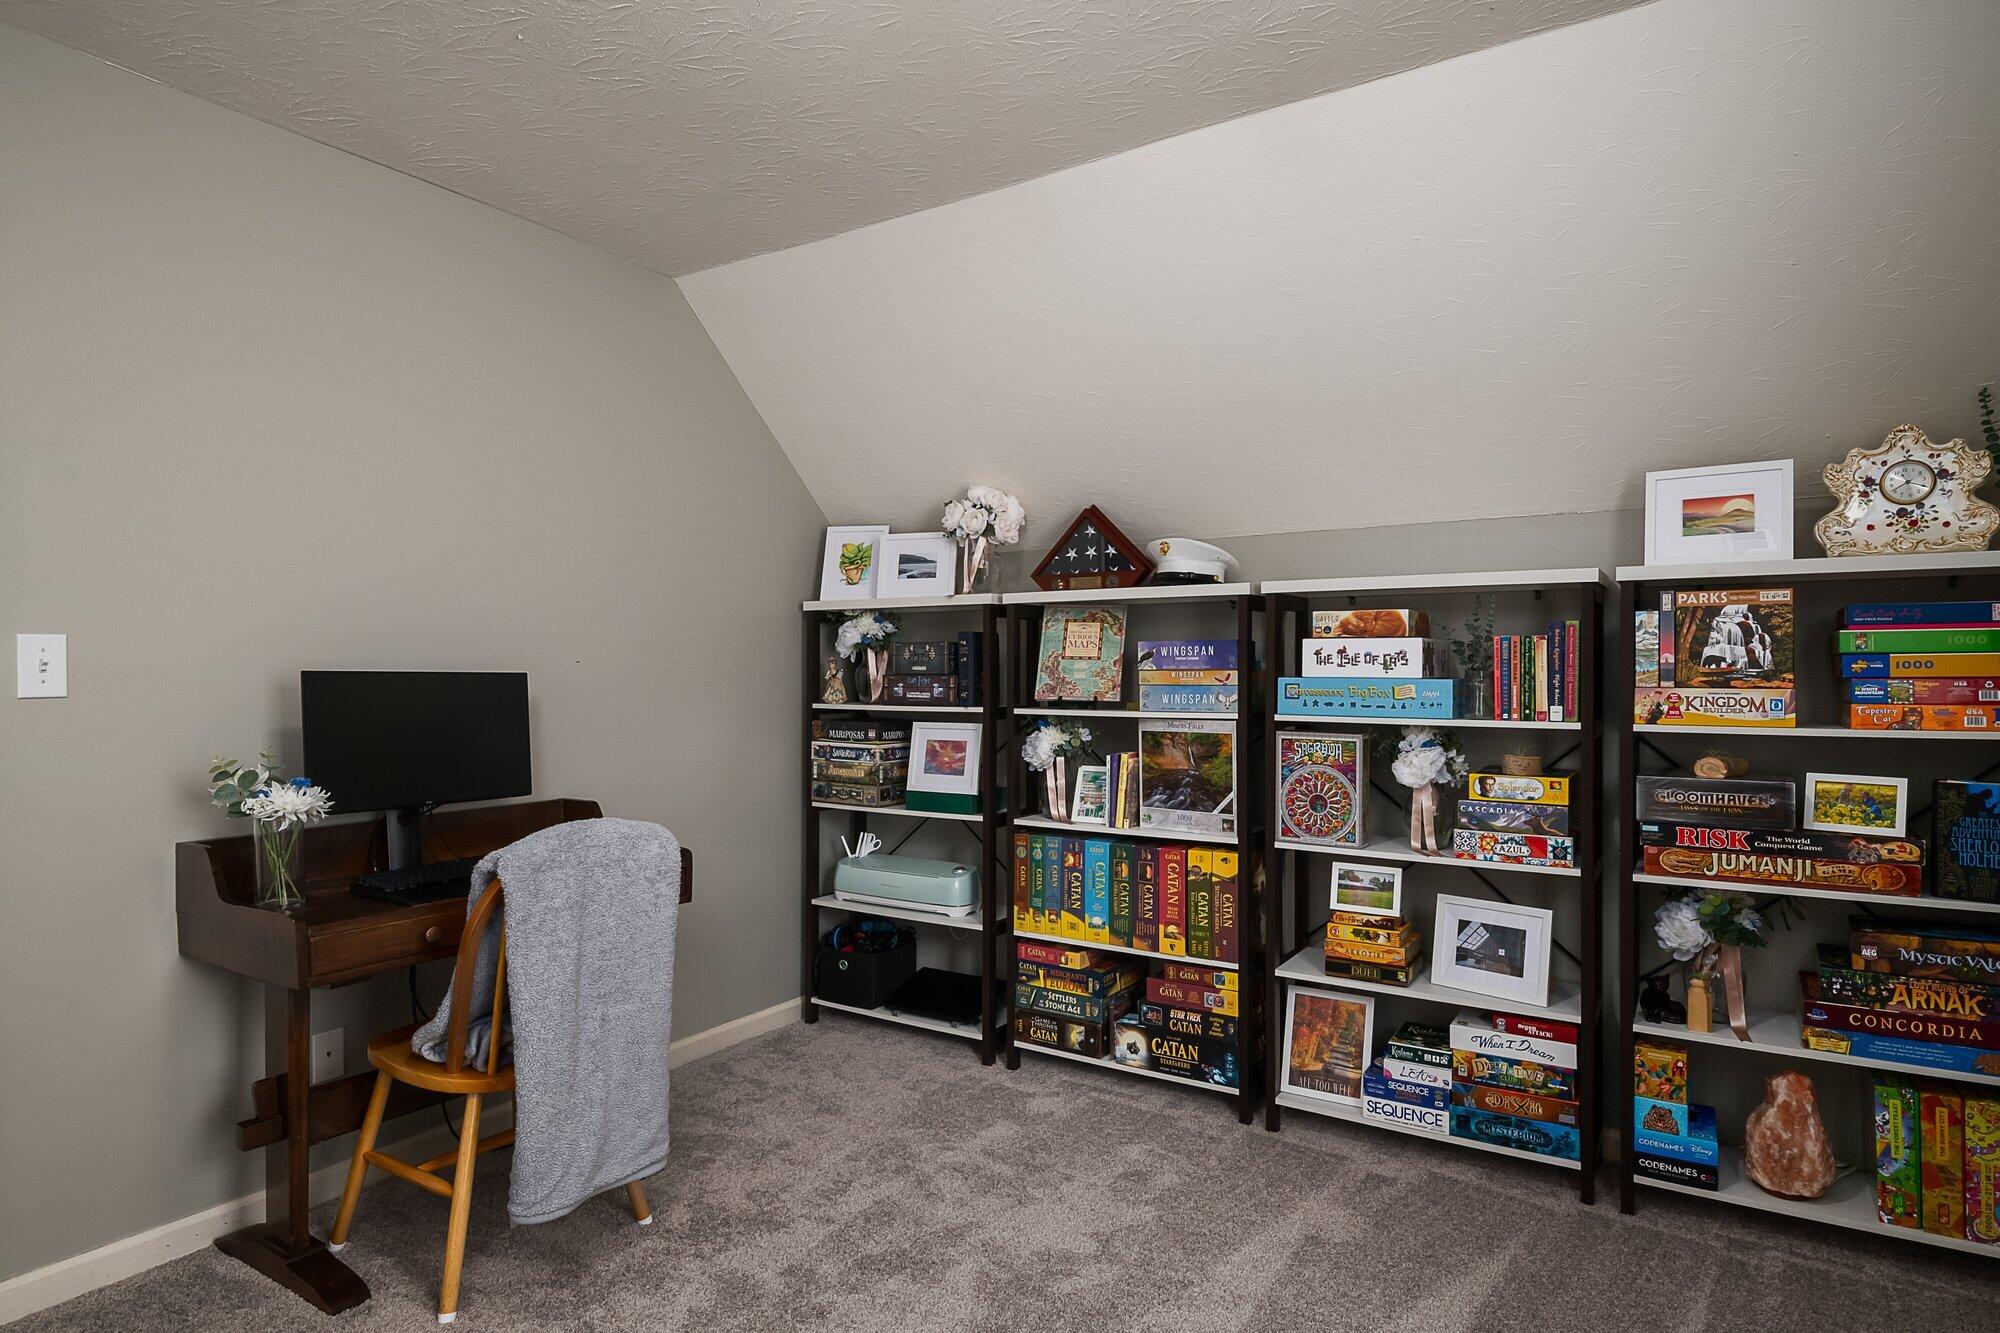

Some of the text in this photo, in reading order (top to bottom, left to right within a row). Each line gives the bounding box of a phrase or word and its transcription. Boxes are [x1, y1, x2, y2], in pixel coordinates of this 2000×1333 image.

[1678, 592, 1728, 604] PARKS
[1948, 635, 1987, 645] 1000
[1161, 646, 1214, 656] WINGSPAN
[1314, 651, 1334, 666] THE
[1337, 650, 1361, 667] ISLE
[1364, 652, 1379, 665] OF
[1896, 660, 1934, 669] 1000
[1162, 694, 1215, 704] WINGSPAN
[1285, 684, 1344, 699] Carcassonne
[1348, 686, 1368, 700] Big
[1368, 686, 1390, 699] Box
[1684, 696, 1767, 714] KINGDOM
[1856, 706, 1897, 717] Tapestry
[1874, 714, 1891, 724] Cat
[829, 730, 865, 739] MARIPOSAS
[1294, 742, 1343, 764] SAGRADA
[1498, 783, 1537, 793] Splendor
[1655, 789, 1775, 808] GLOOMHAVEN
[1460, 805, 1517, 814] CASCADIA
[1959, 817, 2000, 828] GREATES
[1676, 826, 1751, 850] RISK
[1499, 845, 1525, 854] AZUL
[1755, 841, 1795, 850] Conquest
[1951, 838, 2000, 854] SHERLO
[1704, 852, 1812, 882] JUMANJI
[1959, 852, 2000, 868] HOLME
[1095, 862, 1106, 899] CATAN
[1167, 863, 1179, 904] CATAN
[1071, 872, 1082, 909] CATAN
[1120, 883, 1129, 916] CATAN
[1144, 885, 1153, 919] CATAN
[1198, 892, 1209, 927] CATAN
[1222, 894, 1233, 928] CATAN
[1027, 948, 1046, 956] CATAN
[1345, 949, 1385, 959] AKROTIRI
[1898, 948, 1962, 966] MYSTIC
[1019, 962, 1037, 971] CATAN
[1351, 966, 1377, 978] DUEL
[1050, 969, 1086, 982] MERCHANTS
[1180, 971, 1199, 980] CATAN
[1050, 980, 1086, 993] EUROPE
[1160, 987, 1183, 998] CATAN
[1909, 981, 1969, 994] LOST RUINS OF
[1048, 992, 1076, 1004] SETTLERS
[1888, 983, 1986, 1016] ARNAK
[1045, 1000, 1081, 1014] STONE AGE
[1170, 1009, 1202, 1022] STAR TREK
[1031, 1020, 1058, 1030] THRONES
[1170, 1019, 1202, 1035] CATAN
[1849, 1013, 1983, 1040] CONCORDIA
[1030, 1028, 1058, 1042] CATAN
[1152, 1037, 1198, 1061] CATAN
[1392, 1046, 1413, 1058] Kodama
[1471, 1035, 1555, 1062] When I Dream
[1160, 1058, 1190, 1069] STARFARERS
[1299, 1076, 1311, 1089] ALL
[1315, 1079, 1330, 1091] TOO
[1333, 1083, 1352, 1096] WELL
[1500, 1074, 1518, 1085] CLUB
[1388, 1081, 1429, 1096] SEQUENCE
[1367, 1100, 1443, 1126] SEQUENCE
[1483, 1122, 1544, 1143] MYSTERIUM
[1639, 1138, 1684, 1152] CODENAMES
[1690, 1144, 1712, 1156] Disney
[1639, 1159, 1697, 1177] CODENAMES
